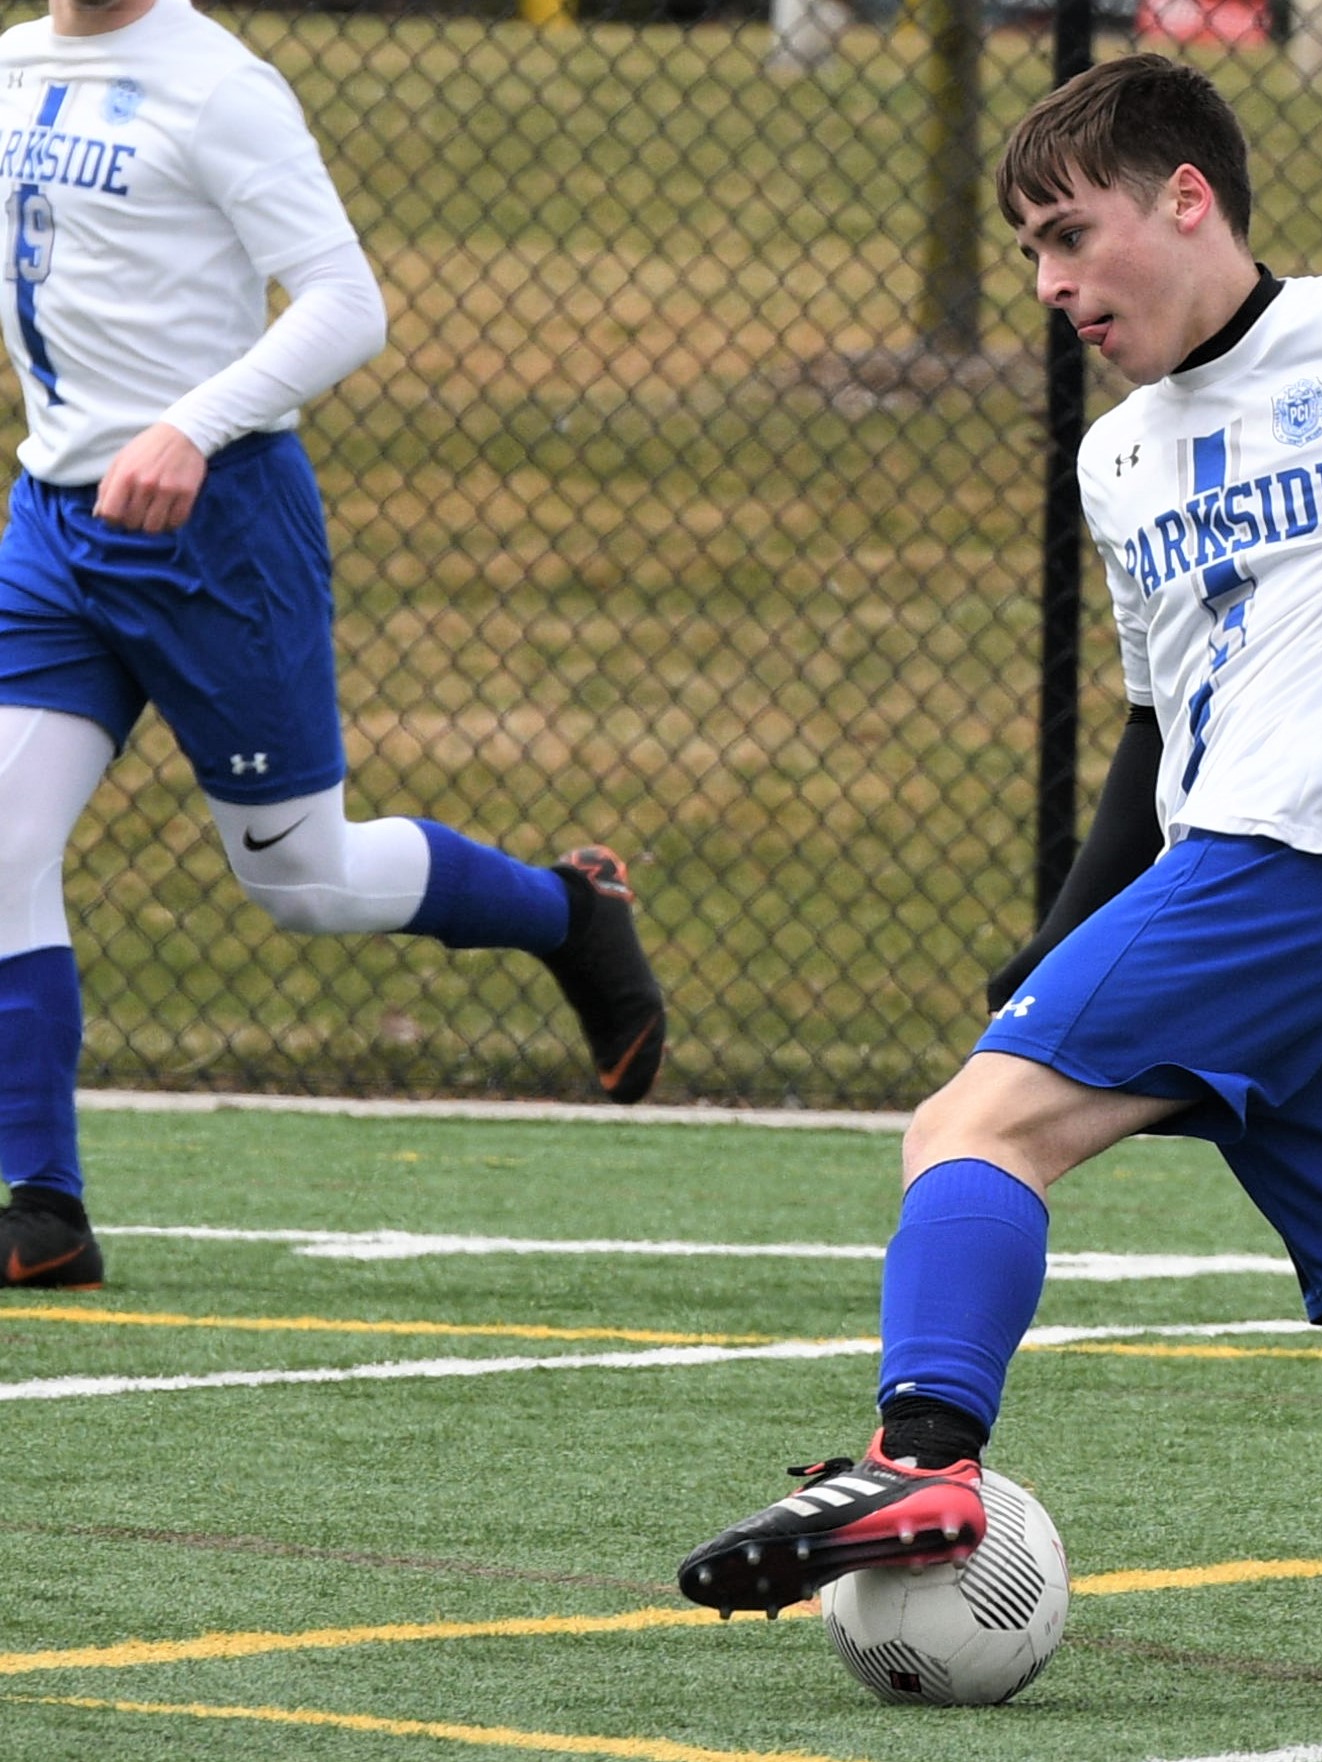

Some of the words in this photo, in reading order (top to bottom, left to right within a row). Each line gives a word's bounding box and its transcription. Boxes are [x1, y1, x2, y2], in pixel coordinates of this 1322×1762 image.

[0, 129, 137, 197] RKSIDE
[4, 190, 55, 284] 19
[1289, 403, 1309, 425] PCI
